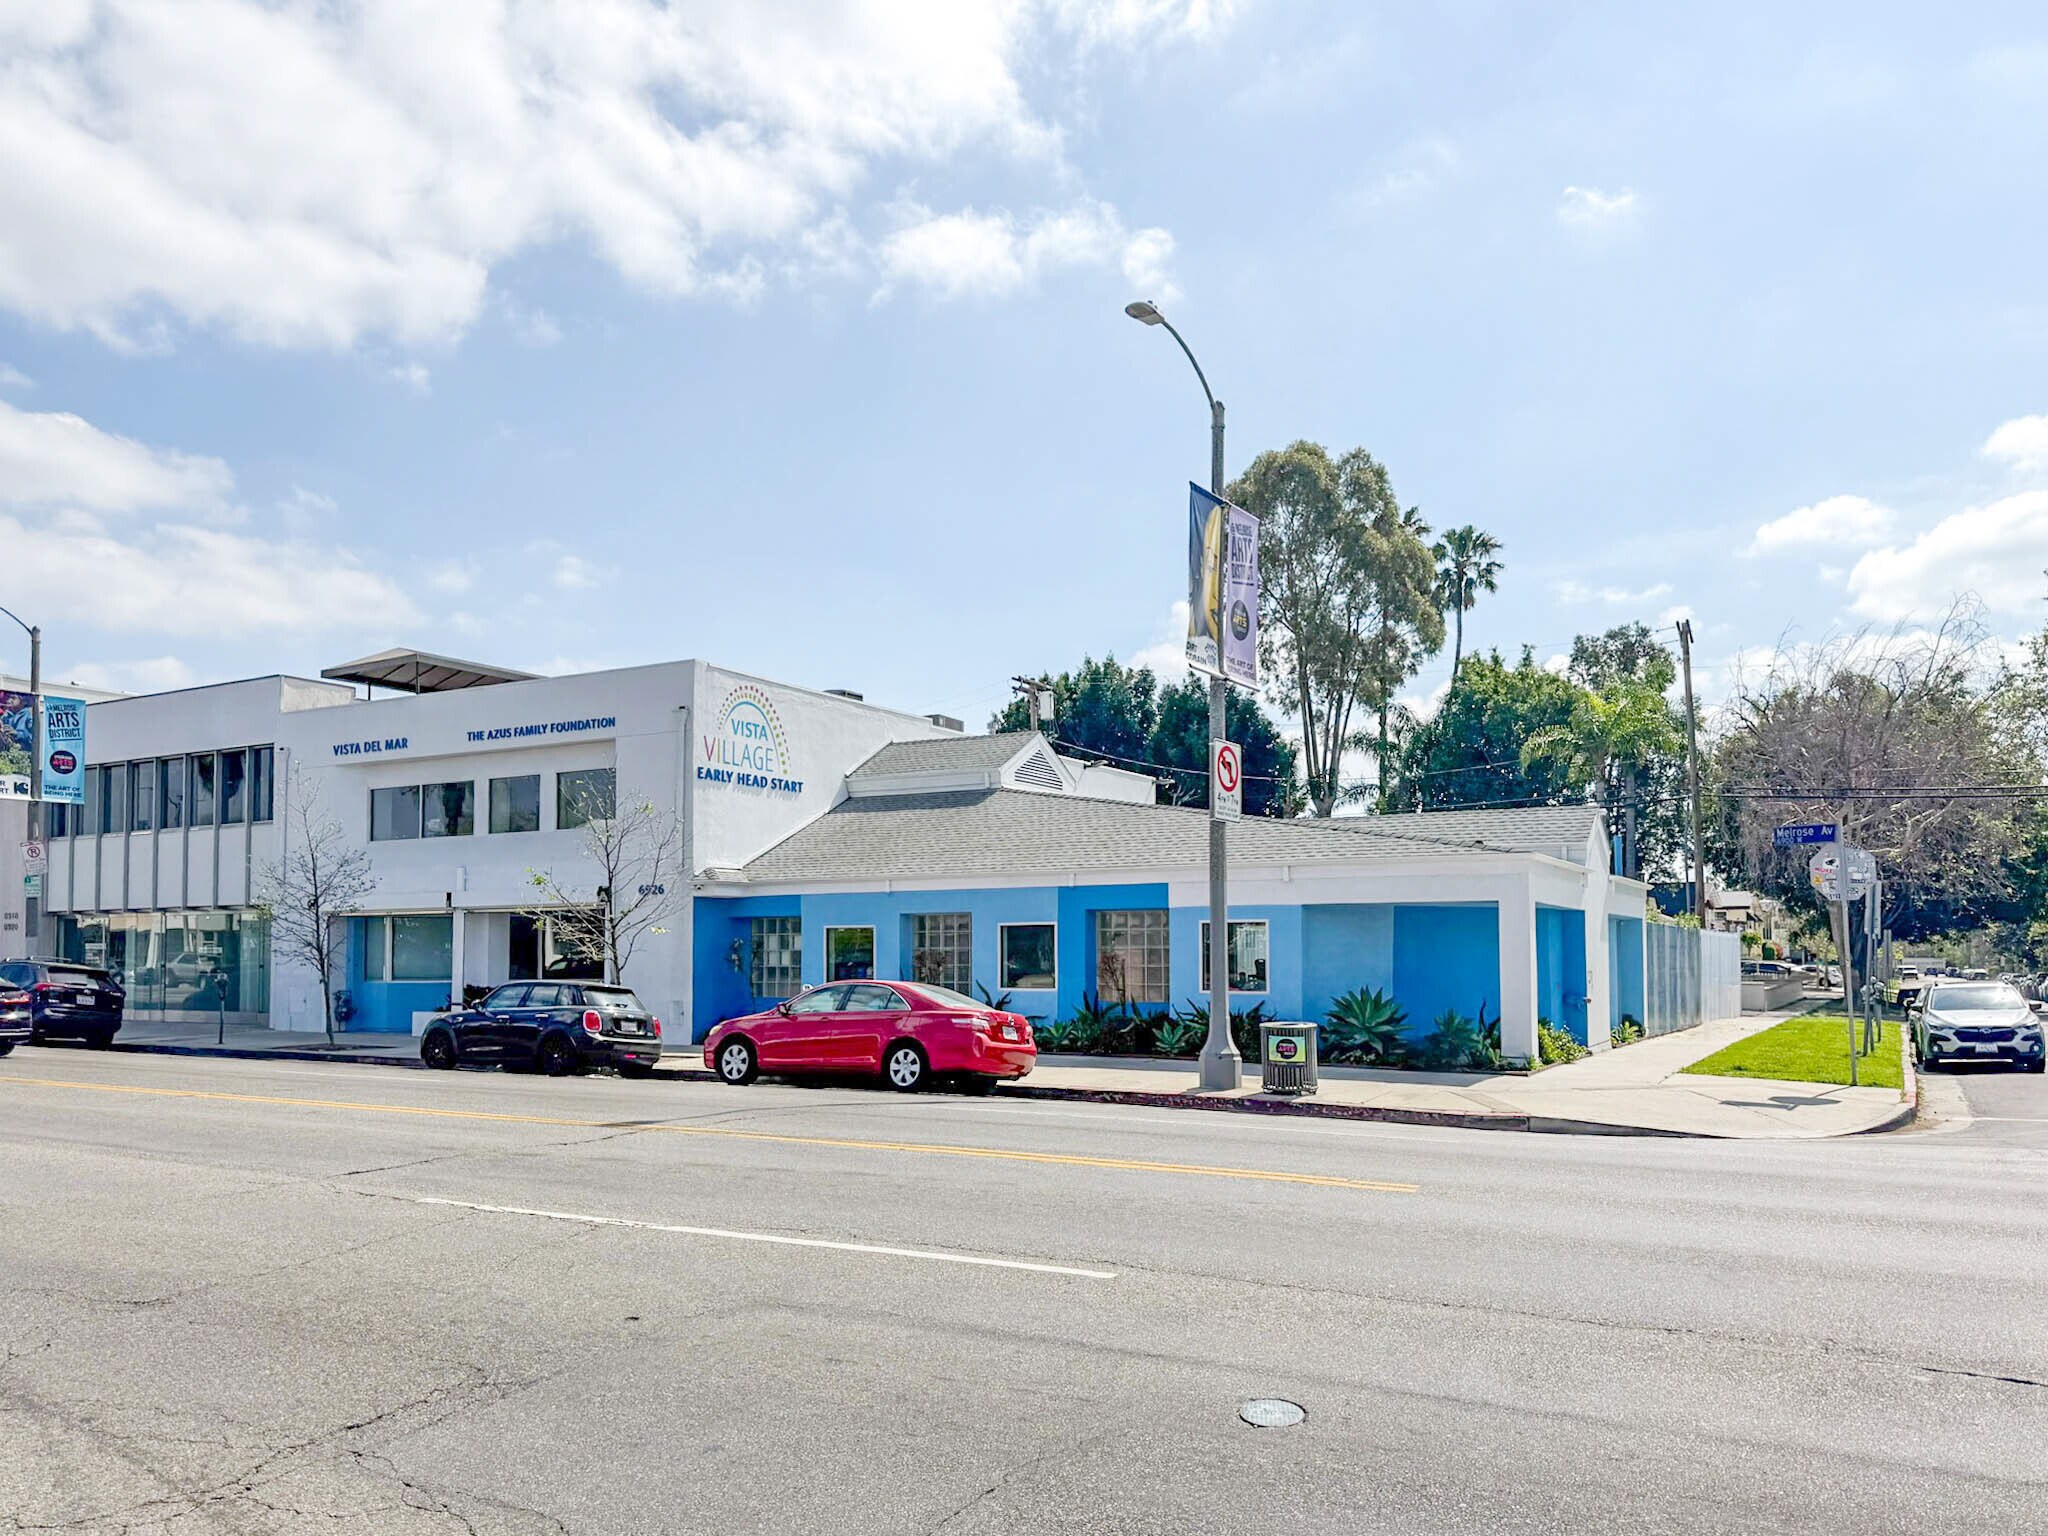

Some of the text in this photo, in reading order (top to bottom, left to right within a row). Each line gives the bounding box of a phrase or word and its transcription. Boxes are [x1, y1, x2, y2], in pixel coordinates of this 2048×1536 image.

[1231, 535, 1253, 564] ARTS
[53, 703, 77, 712] MELROSE
[48, 712, 79, 728] ARTS
[467, 717, 616, 741] THE AZUS FAMILY FOUNDATION
[731, 718, 768, 741] VISTA
[49, 728, 81, 738] DISTRICT
[333, 737, 408, 756] VISTA DEL MAR
[703, 735, 775, 772] VILLAGE
[697, 766, 804, 793] EARLY HEAD START
[1776, 825, 1833, 838] Melrose Av
[638, 884, 665, 895] 6926
